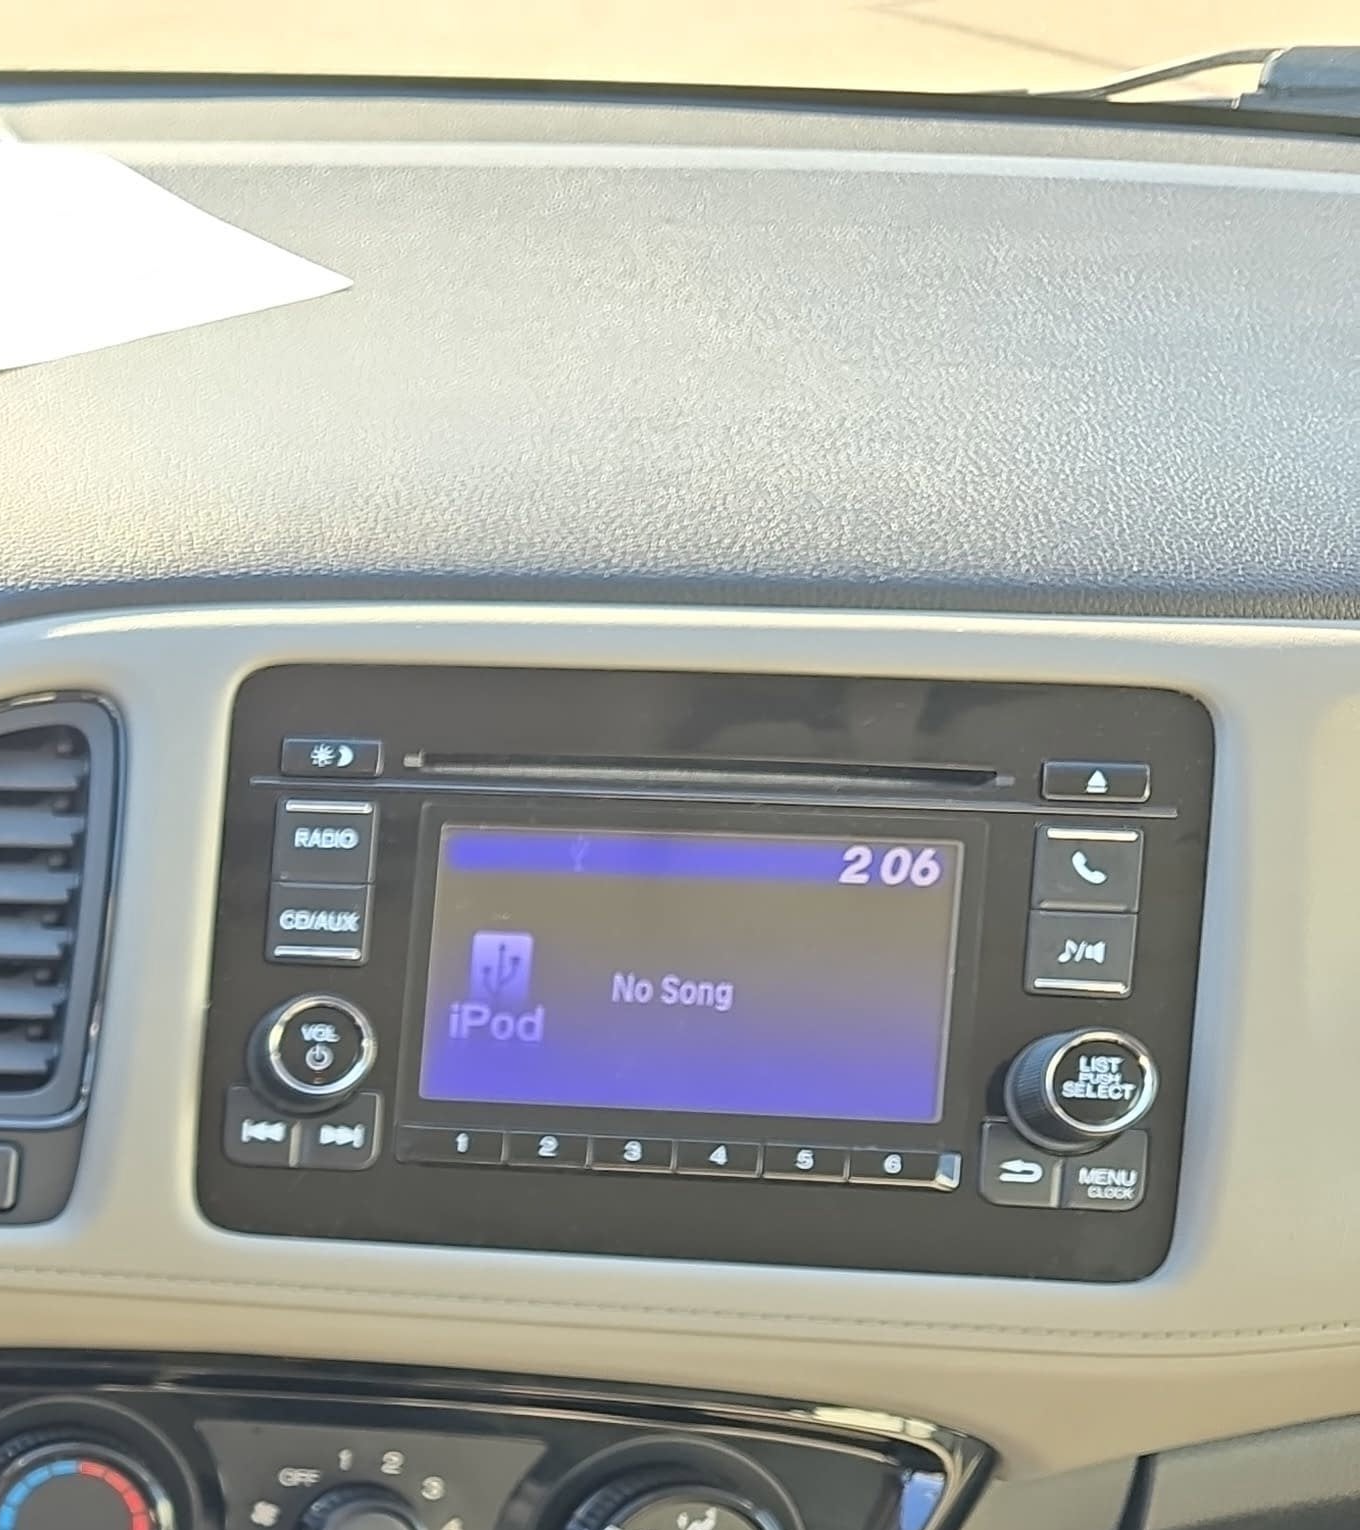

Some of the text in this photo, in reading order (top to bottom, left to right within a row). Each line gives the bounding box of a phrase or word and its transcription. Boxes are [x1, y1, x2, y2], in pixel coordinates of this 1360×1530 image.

[294, 826, 359, 850] RADIO
[280, 909, 359, 933] CD/AUX
[612, 971, 734, 1012] No Song
[301, 1025, 340, 1042] VOL
[448, 1003, 545, 1043] iPod
[1078, 1056, 1124, 1074] LIST
[1078, 1072, 1122, 1084] PUSH
[1062, 1081, 1137, 1100] SELECT
[455, 1132, 469, 1154] 1
[537, 1136, 560, 1159] 2
[623, 1140, 643, 1162] 3
[708, 1145, 729, 1167] 4
[796, 1149, 815, 1171] 5
[883, 1153, 903, 1176] 6
[1078, 1167, 1137, 1187] MENU
[1088, 1185, 1136, 1200] CLOCK
[338, 1449, 353, 1471] 1
[381, 1451, 405, 1476] 2
[279, 1467, 322, 1487] OFF
[421, 1476, 445, 1501] 3
